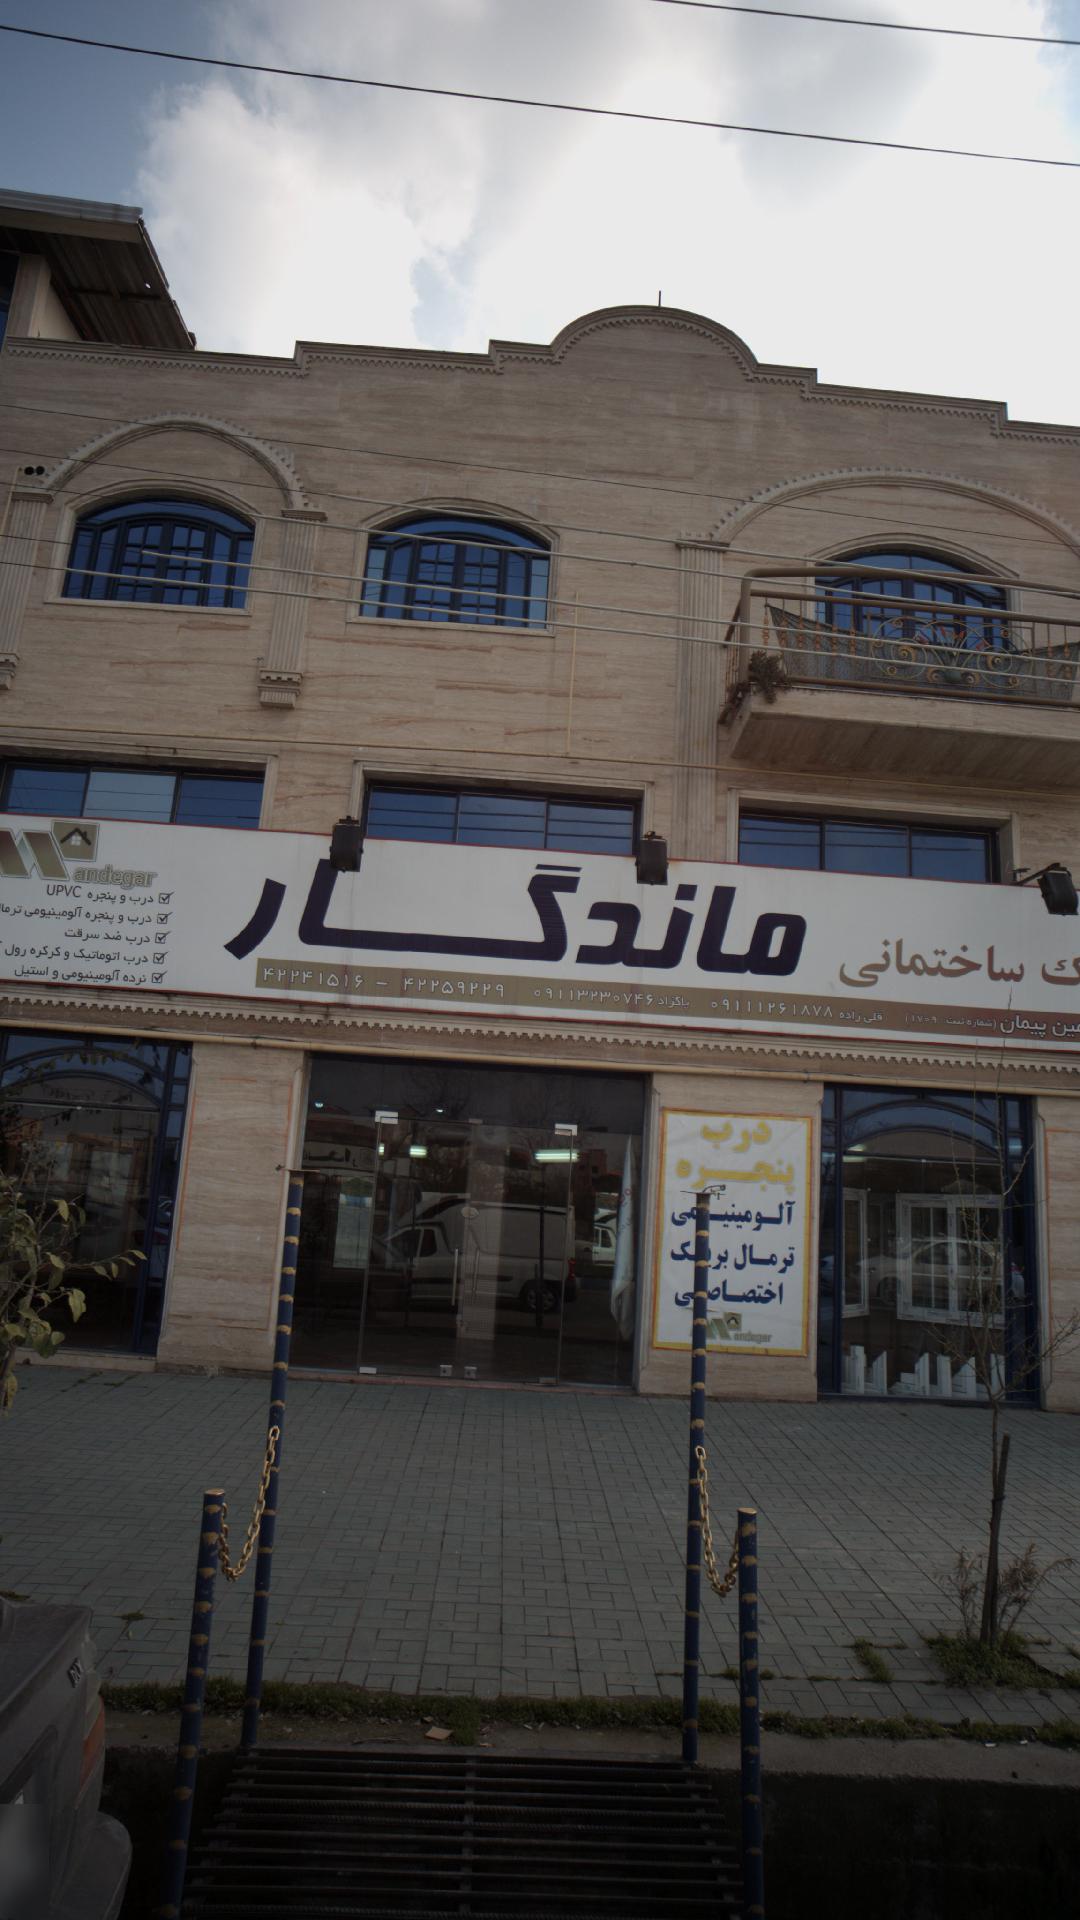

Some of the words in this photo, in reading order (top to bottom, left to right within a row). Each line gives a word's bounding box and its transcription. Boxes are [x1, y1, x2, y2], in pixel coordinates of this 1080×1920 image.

[46, 884, 82, 898] UPVC
[87, 891, 117, 904] پنجره
[119, 894, 126, 904] و
[129, 895, 154, 905] درب
[0, 903, 23, 916] ترما
[24, 906, 83, 920] آلومینیومی
[85, 911, 115, 924] پنجره
[118, 914, 124, 924] و
[127, 915, 152, 925] درب
[224, 858, 807, 976] ماندگار
[64, 928, 100, 941] سرقت
[103, 930, 122, 941] ضد
[125, 935, 151, 945] درب
[4, 943, 26, 957] رول
[30, 945, 61, 959] کرکره
[64, 950, 70, 960] و
[73, 948, 120, 963] اتوماتیک
[123, 955, 149, 965] درب
[839, 938, 1025, 988] ساختمانی
[14, 964, 49, 978] استیل
[52, 969, 59, 980] و
[61, 969, 121, 983] آلومینیومی
[122, 974, 146, 986] نرده
[1000, 1014, 1047, 1038] پیمان
[702, 1121, 773, 1153] درب
[675, 1158, 796, 1195] پنجره
[671, 1200, 796, 1231] آلومینیمی
[670, 1240, 729, 1270] برک
[733, 1243, 795, 1274] ترمال
